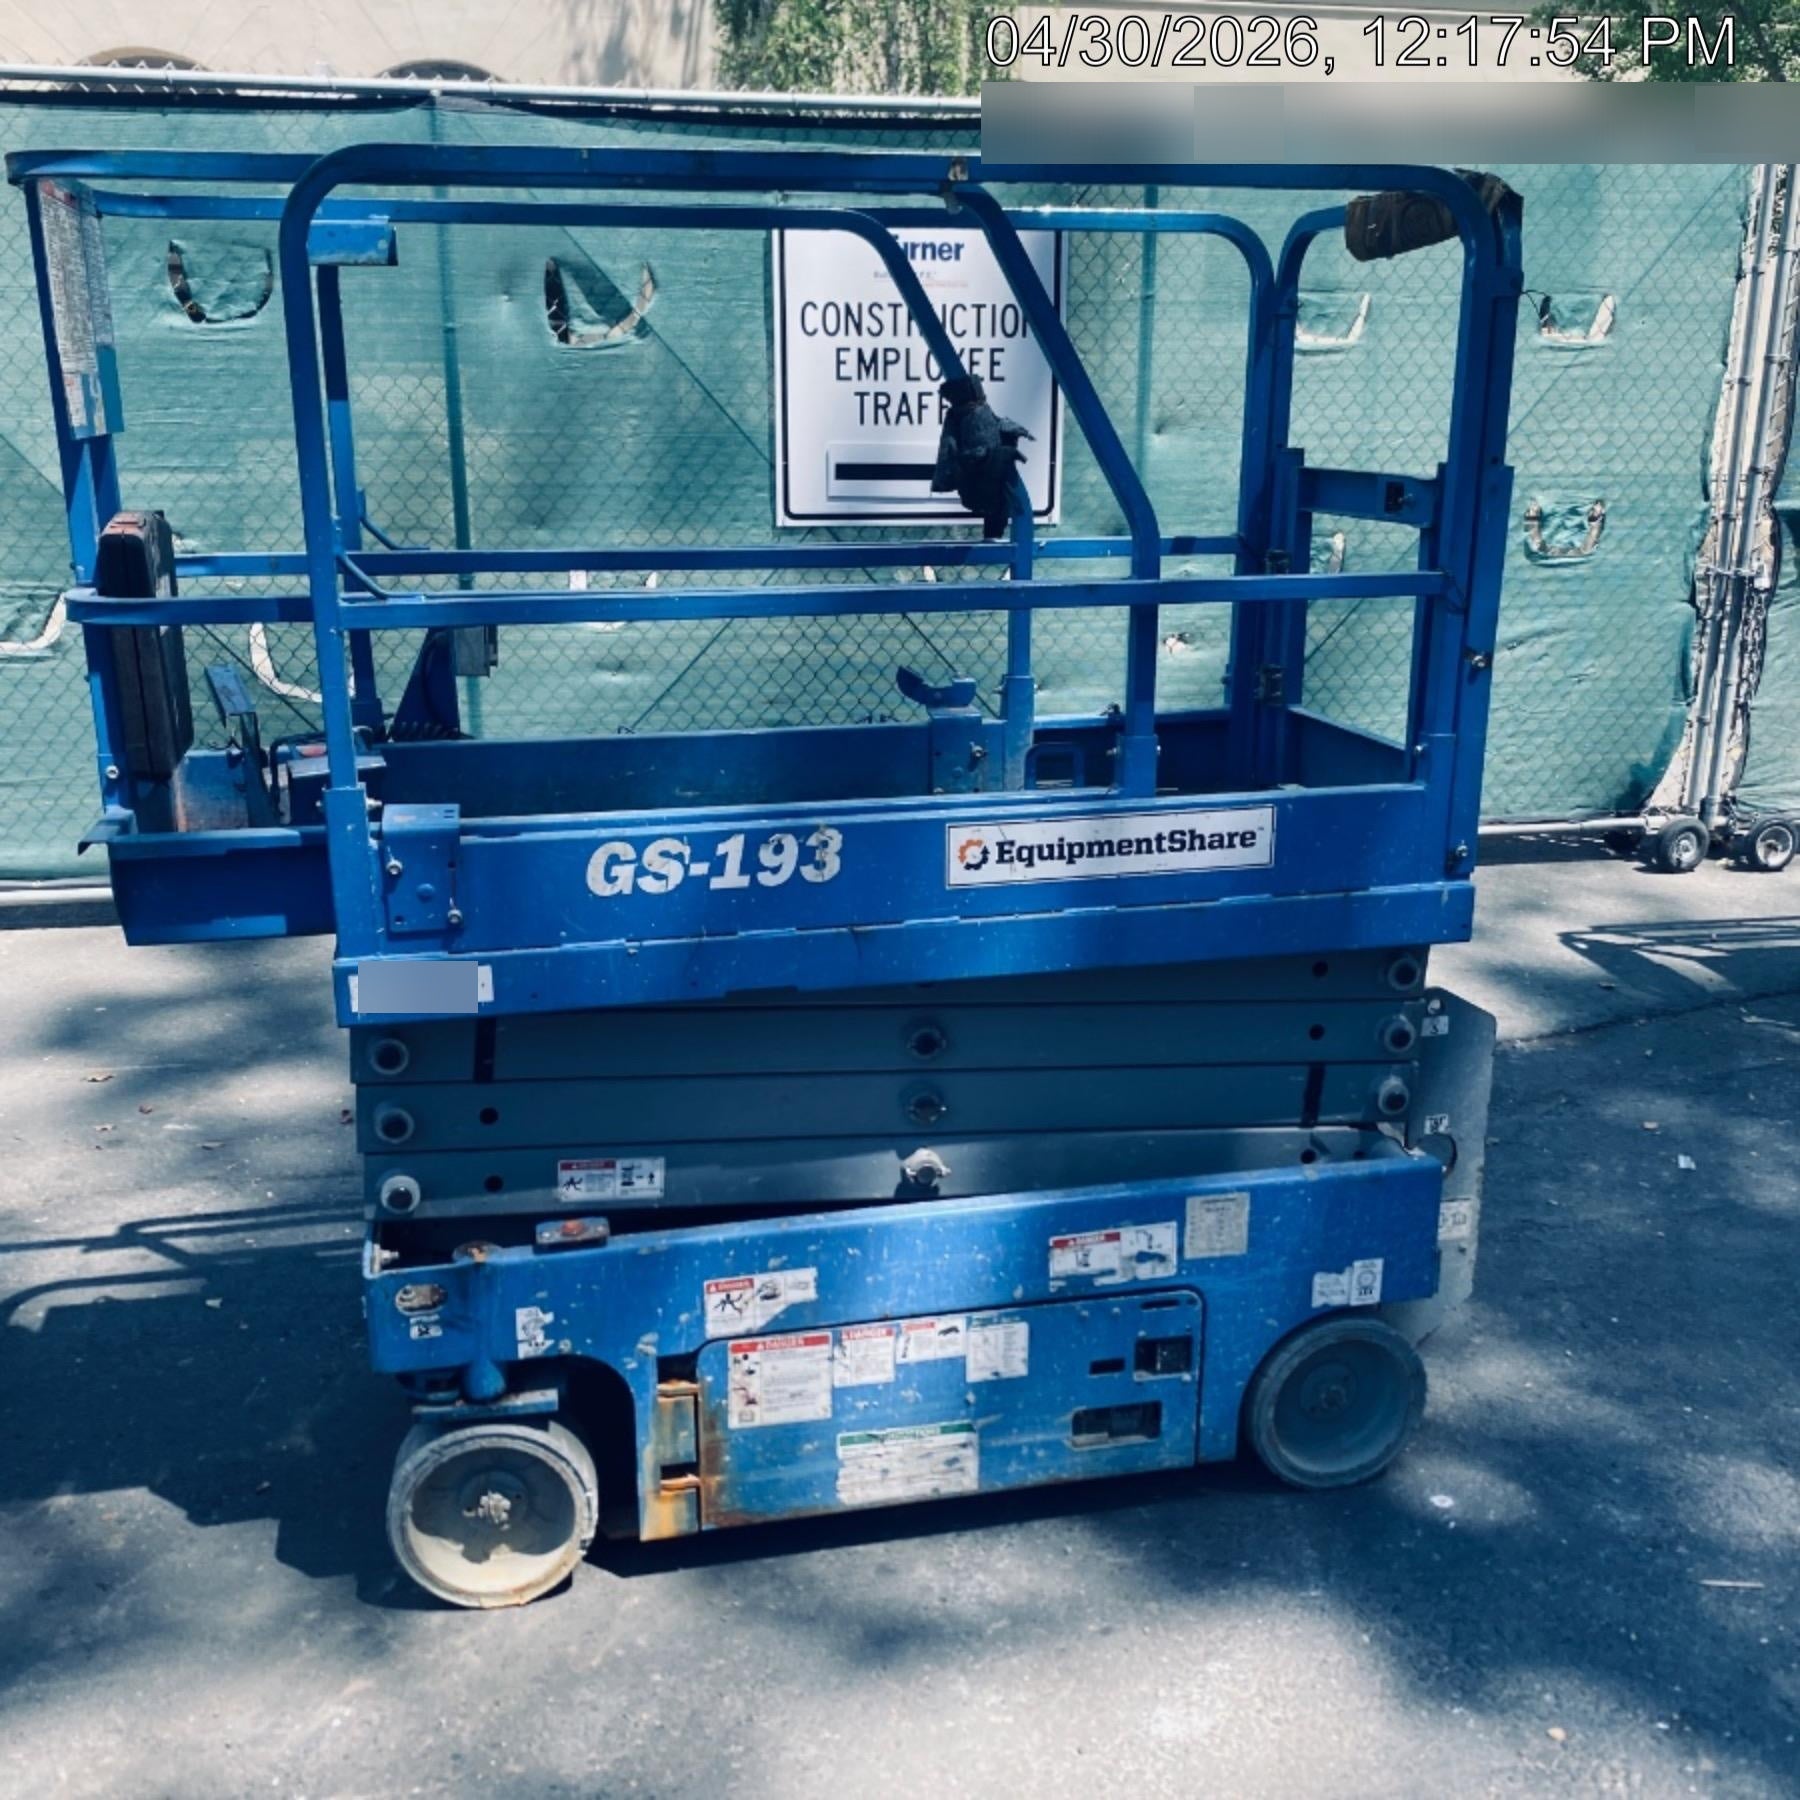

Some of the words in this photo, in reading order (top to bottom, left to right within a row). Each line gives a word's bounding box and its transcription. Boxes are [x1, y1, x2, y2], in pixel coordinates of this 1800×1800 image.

[892, 234, 965, 261] rner
[835, 347, 1006, 382] EMPLOEE
[585, 826, 843, 897] GS-193
[995, 828, 1258, 868] EquipmentShare
